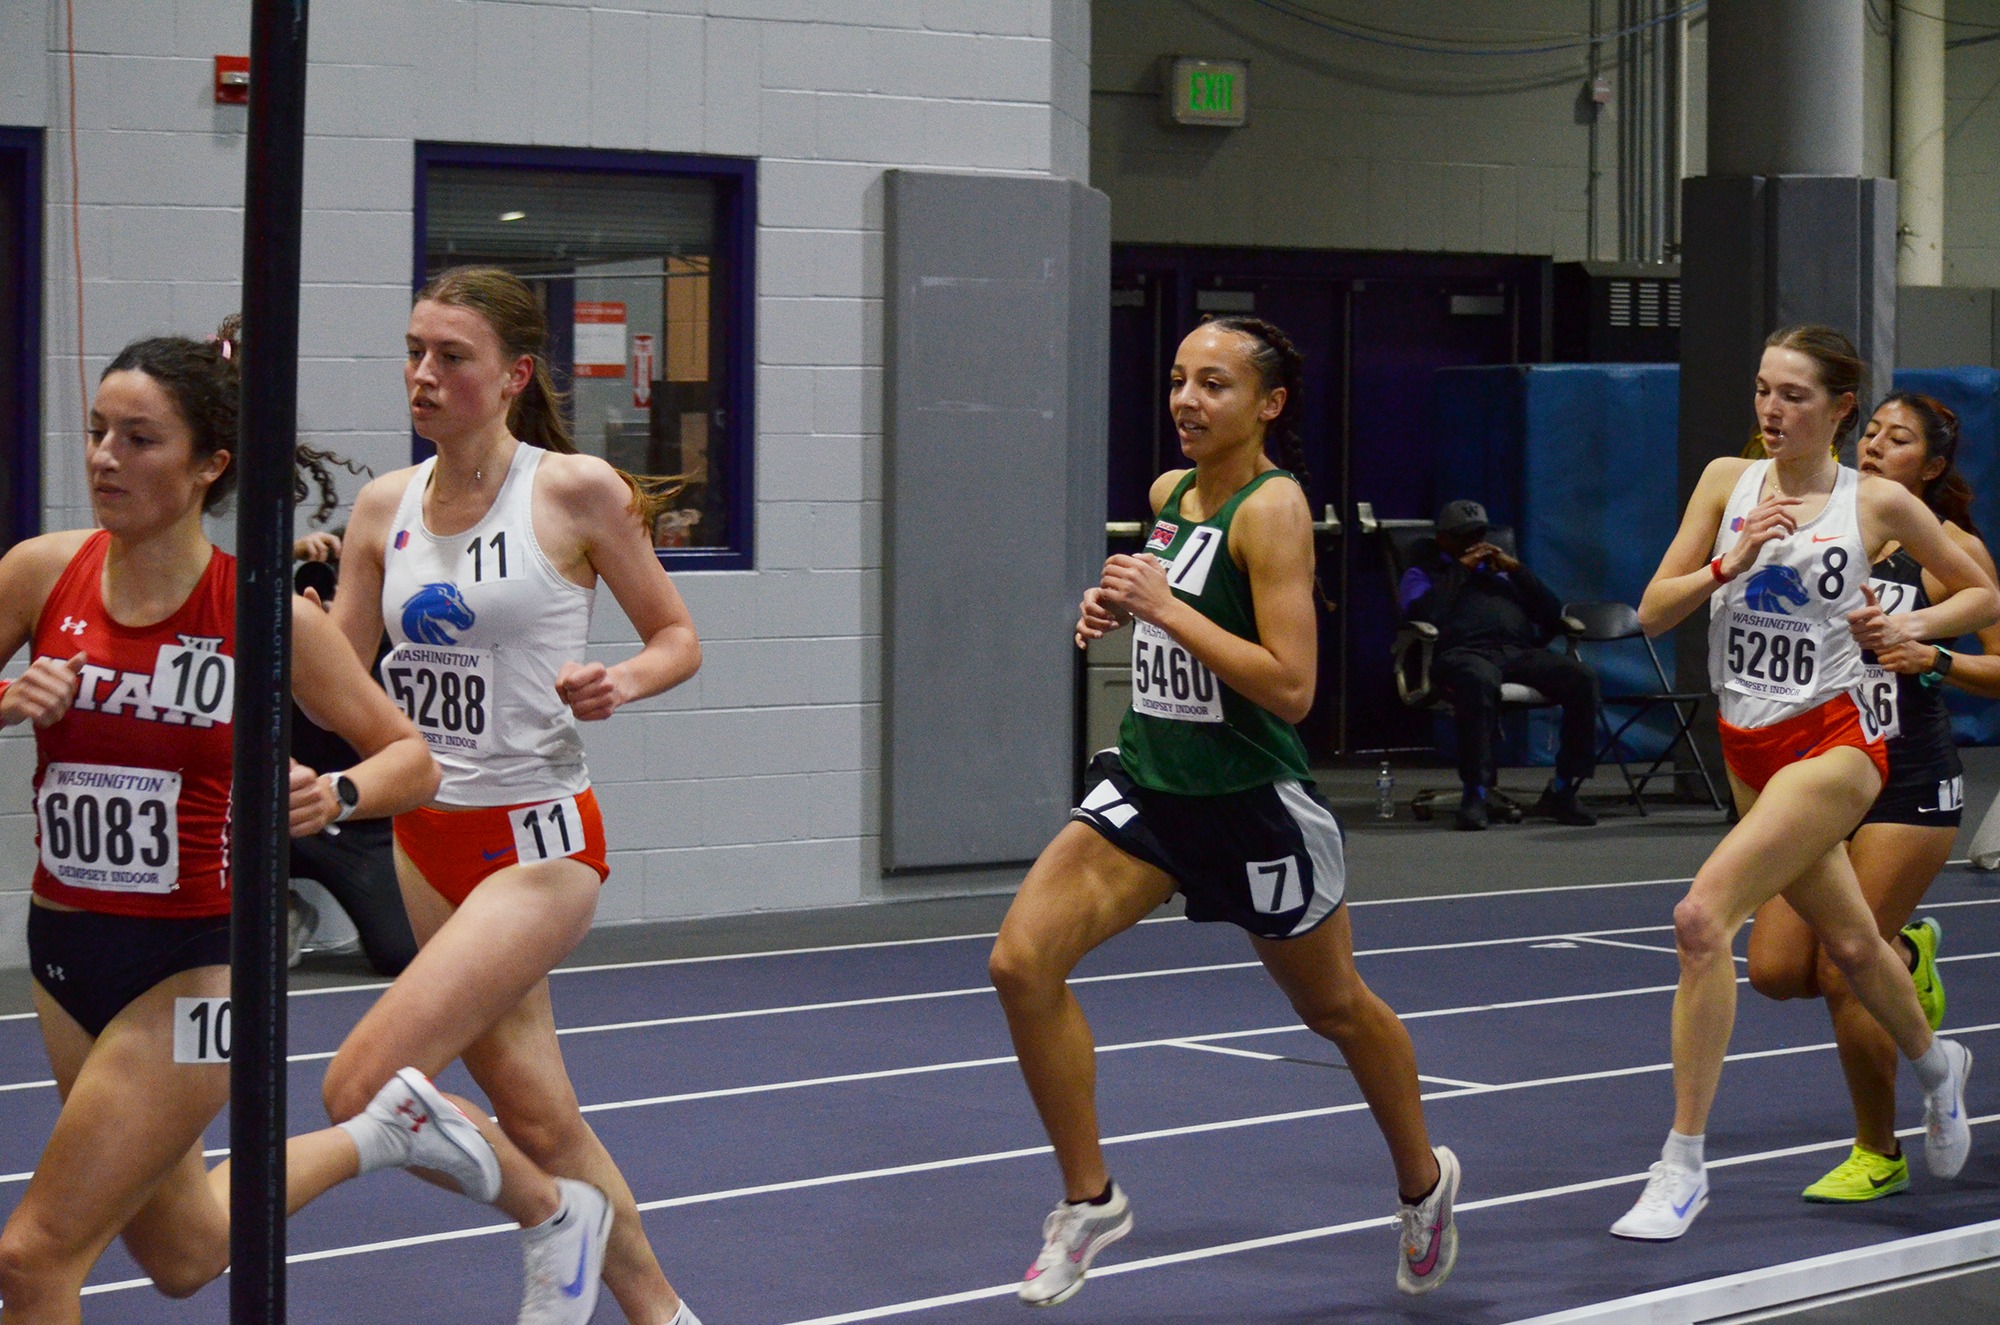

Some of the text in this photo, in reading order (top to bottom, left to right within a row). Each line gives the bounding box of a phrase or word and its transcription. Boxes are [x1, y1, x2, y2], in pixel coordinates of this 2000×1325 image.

[1190, 72, 1233, 111] EXIT
[467, 531, 507, 582] 11
[1174, 531, 1212, 584] 7
[1818, 546, 1848, 600] 8
[1733, 612, 1812, 633] WASHINGTON
[393, 650, 480, 667] WASHINGTON
[1136, 640, 1213, 702] 5460
[1728, 626, 1816, 686] 5286
[172, 651, 226, 714] 10
[388, 668, 485, 735] 5288
[1142, 698, 1173, 712] DEMPSEY
[1175, 704, 1209, 715] INDOOR
[445, 735, 477, 749] INDOOR
[57, 770, 164, 793] WASHINGTON
[45, 792, 169, 867] 6083
[523, 803, 571, 859] 11
[58, 865, 108, 881] DEMPSEY
[111, 870, 159, 884] INDOOR
[1258, 863, 1287, 911] 7
[189, 1001, 231, 1059] 10
